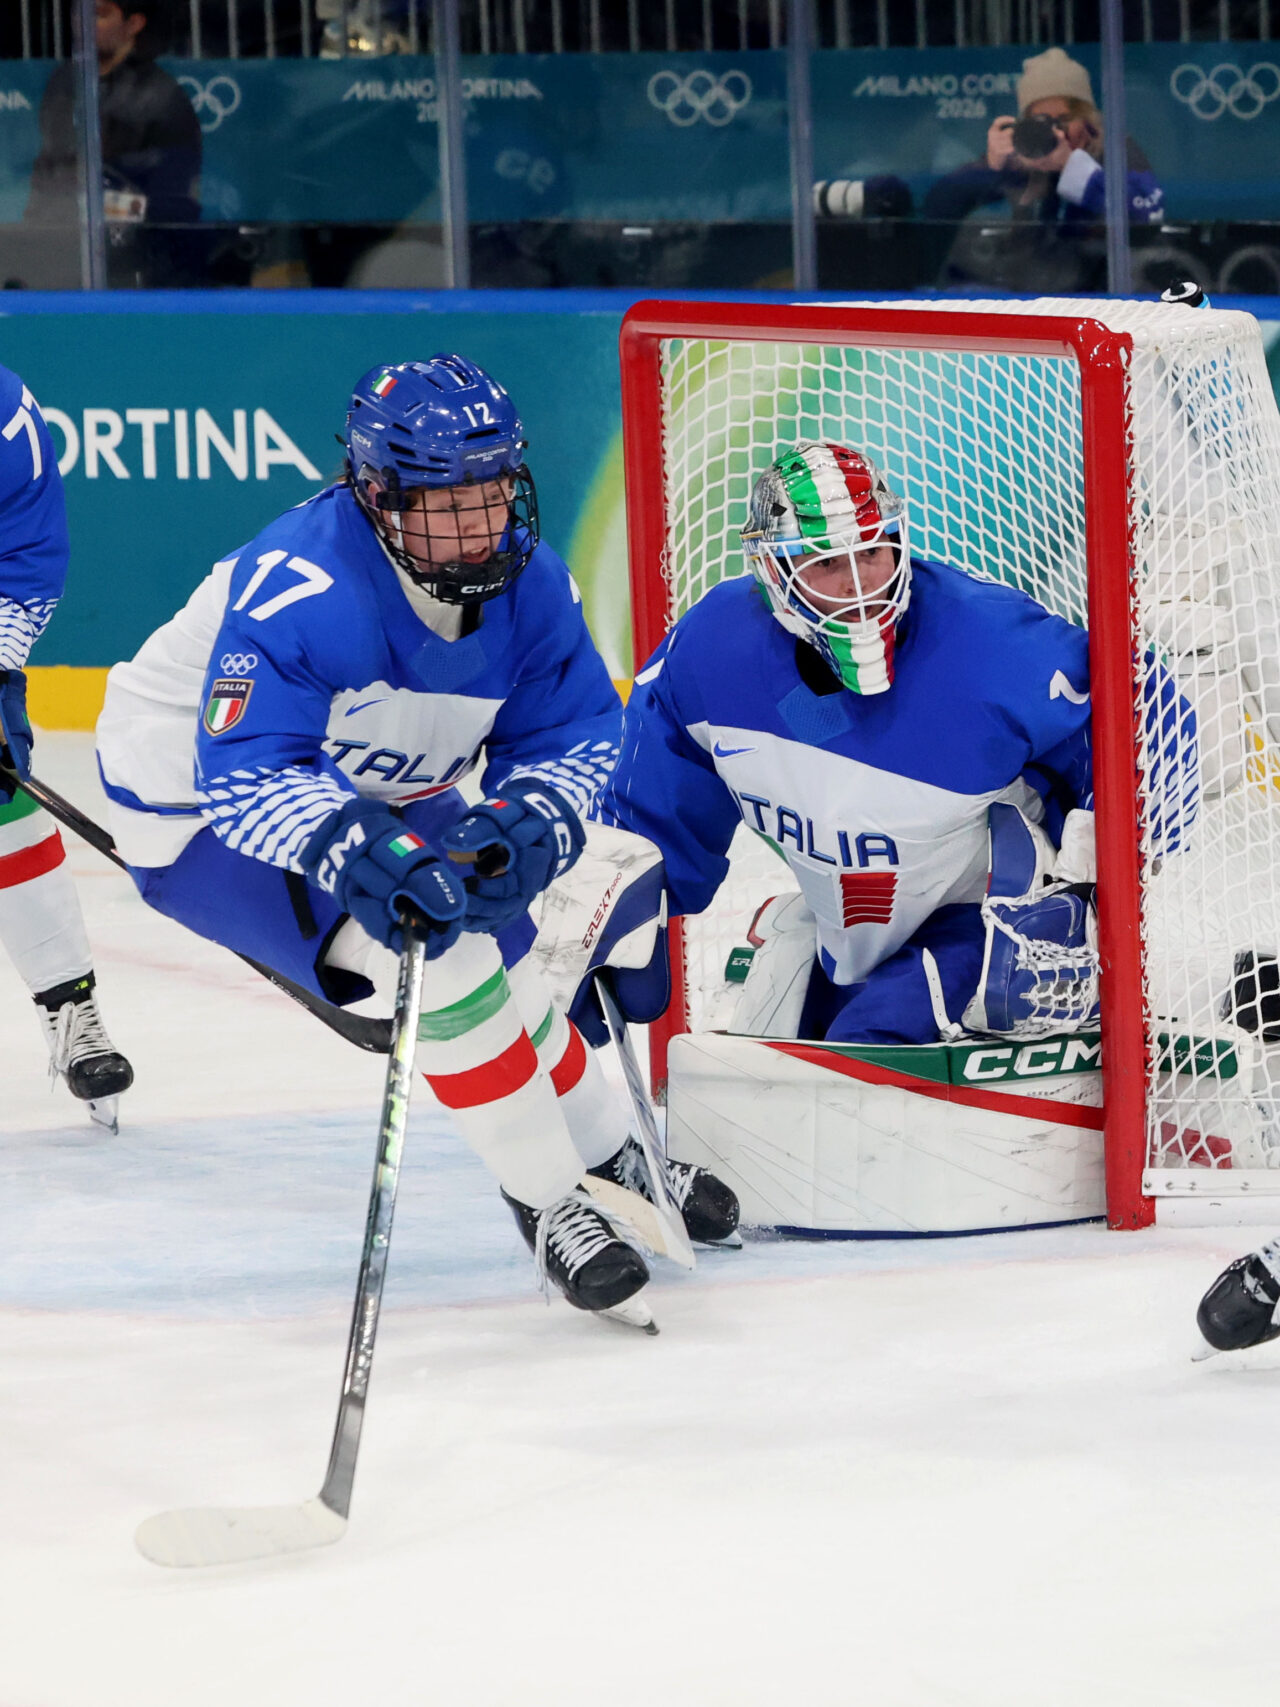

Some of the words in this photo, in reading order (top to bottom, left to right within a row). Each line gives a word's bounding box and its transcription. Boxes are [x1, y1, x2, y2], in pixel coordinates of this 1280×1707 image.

[342, 78, 434, 101] MILANO
[853, 75, 958, 97] MILANO
[935, 98, 988, 120] 2026
[232, 549, 335, 622] 17
[214, 683, 247, 692] ITALIA
[331, 738, 468, 784] TALI
[317, 821, 366, 894] CM
[962, 1039, 1103, 1080] CCM
